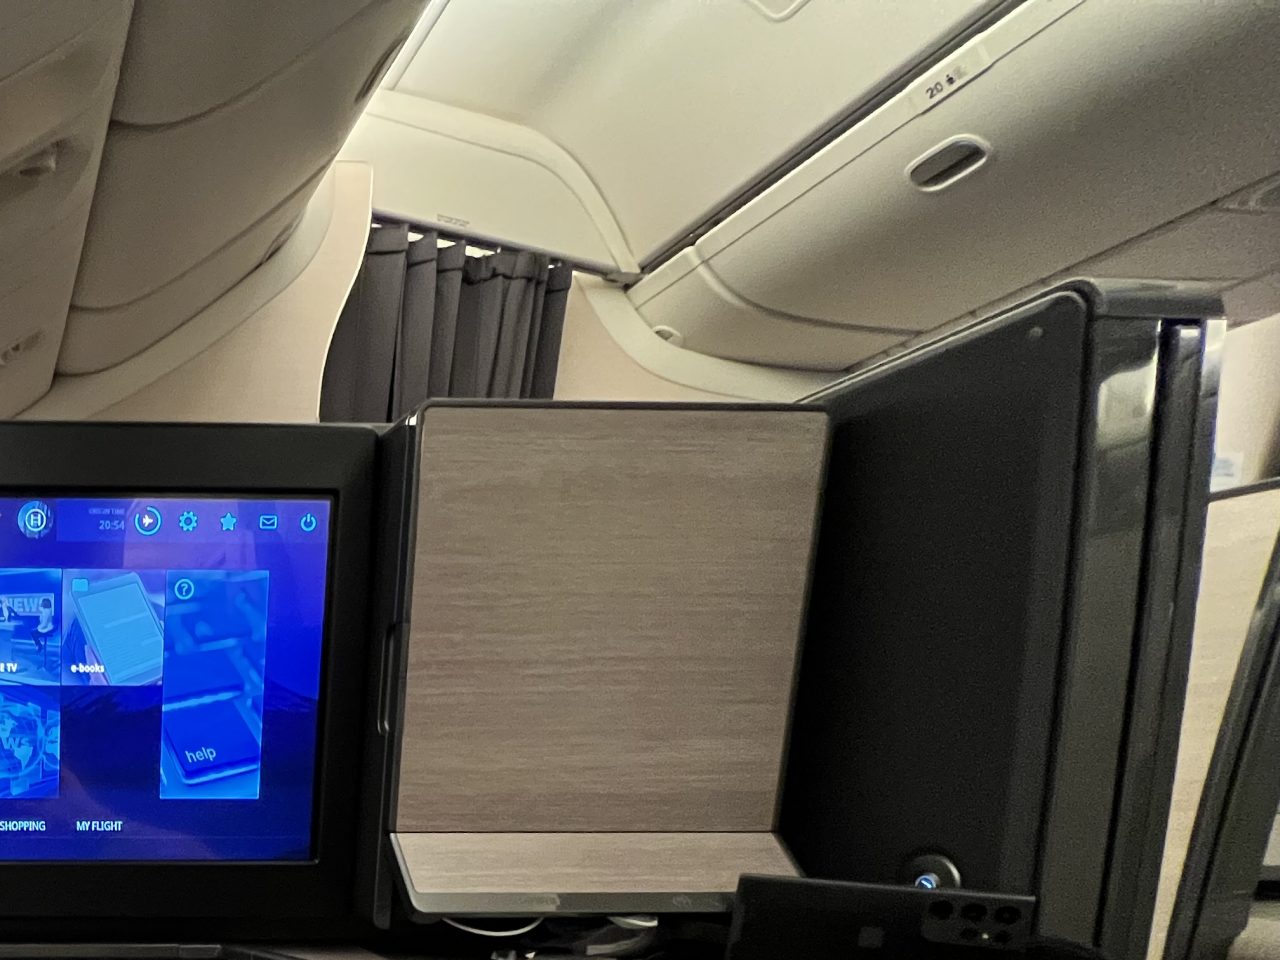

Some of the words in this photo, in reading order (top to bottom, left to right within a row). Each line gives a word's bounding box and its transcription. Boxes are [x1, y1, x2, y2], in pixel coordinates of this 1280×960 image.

[99, 520, 125, 530] 20:54
[6, 663, 18, 673] TV
[71, 662, 105, 673] e-books
[185, 746, 217, 763] help
[0, 820, 46, 832] SHOPPING
[76, 821, 91, 832] MY
[92, 820, 123, 832] FLIGHT
